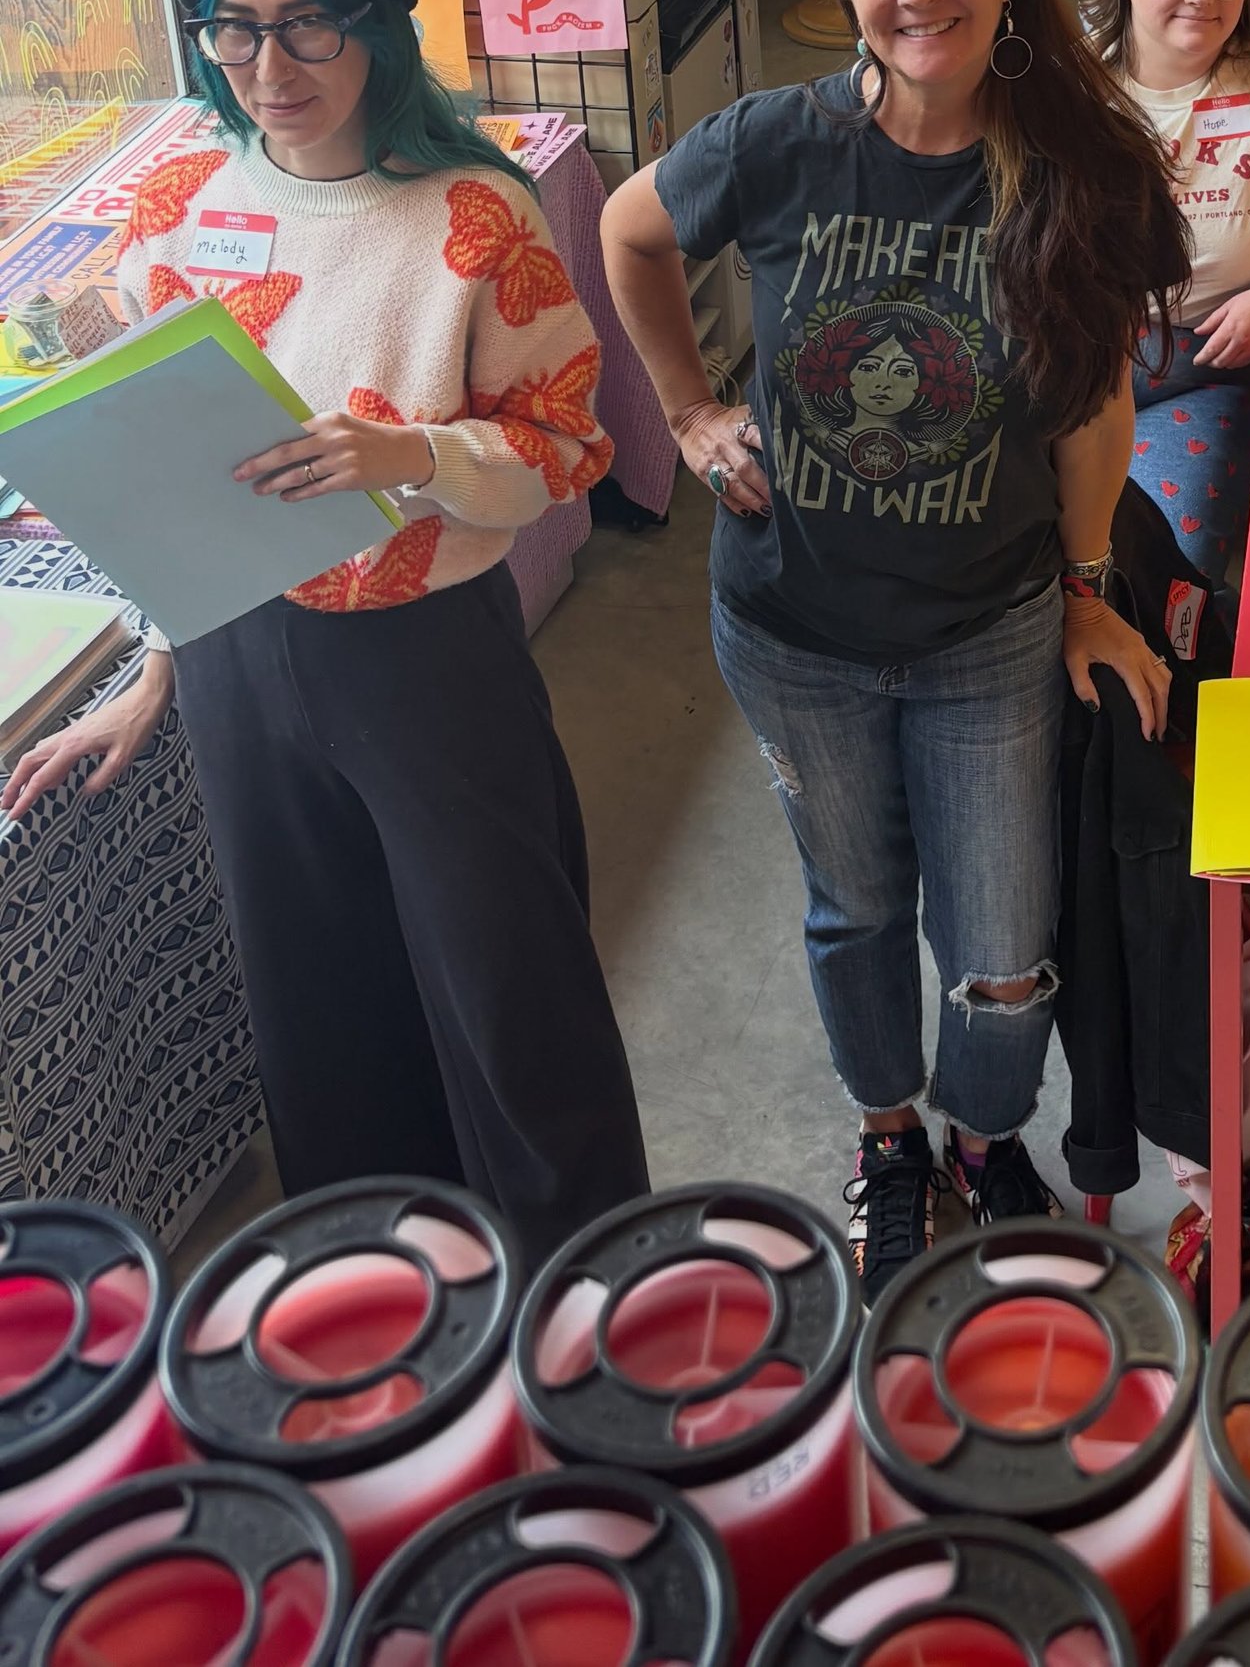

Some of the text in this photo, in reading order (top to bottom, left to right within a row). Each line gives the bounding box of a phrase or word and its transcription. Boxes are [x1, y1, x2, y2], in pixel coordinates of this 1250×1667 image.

[562, 14, 592, 30] RACISM
[1212, 97, 1231, 106] Hello
[1203, 118, 1229, 131] Hope
[225, 214, 248, 225] Hello
[71, 254, 107, 281] CALL
[780, 212, 995, 325] MAKE AR
[774, 393, 1003, 525] NOT WAR
